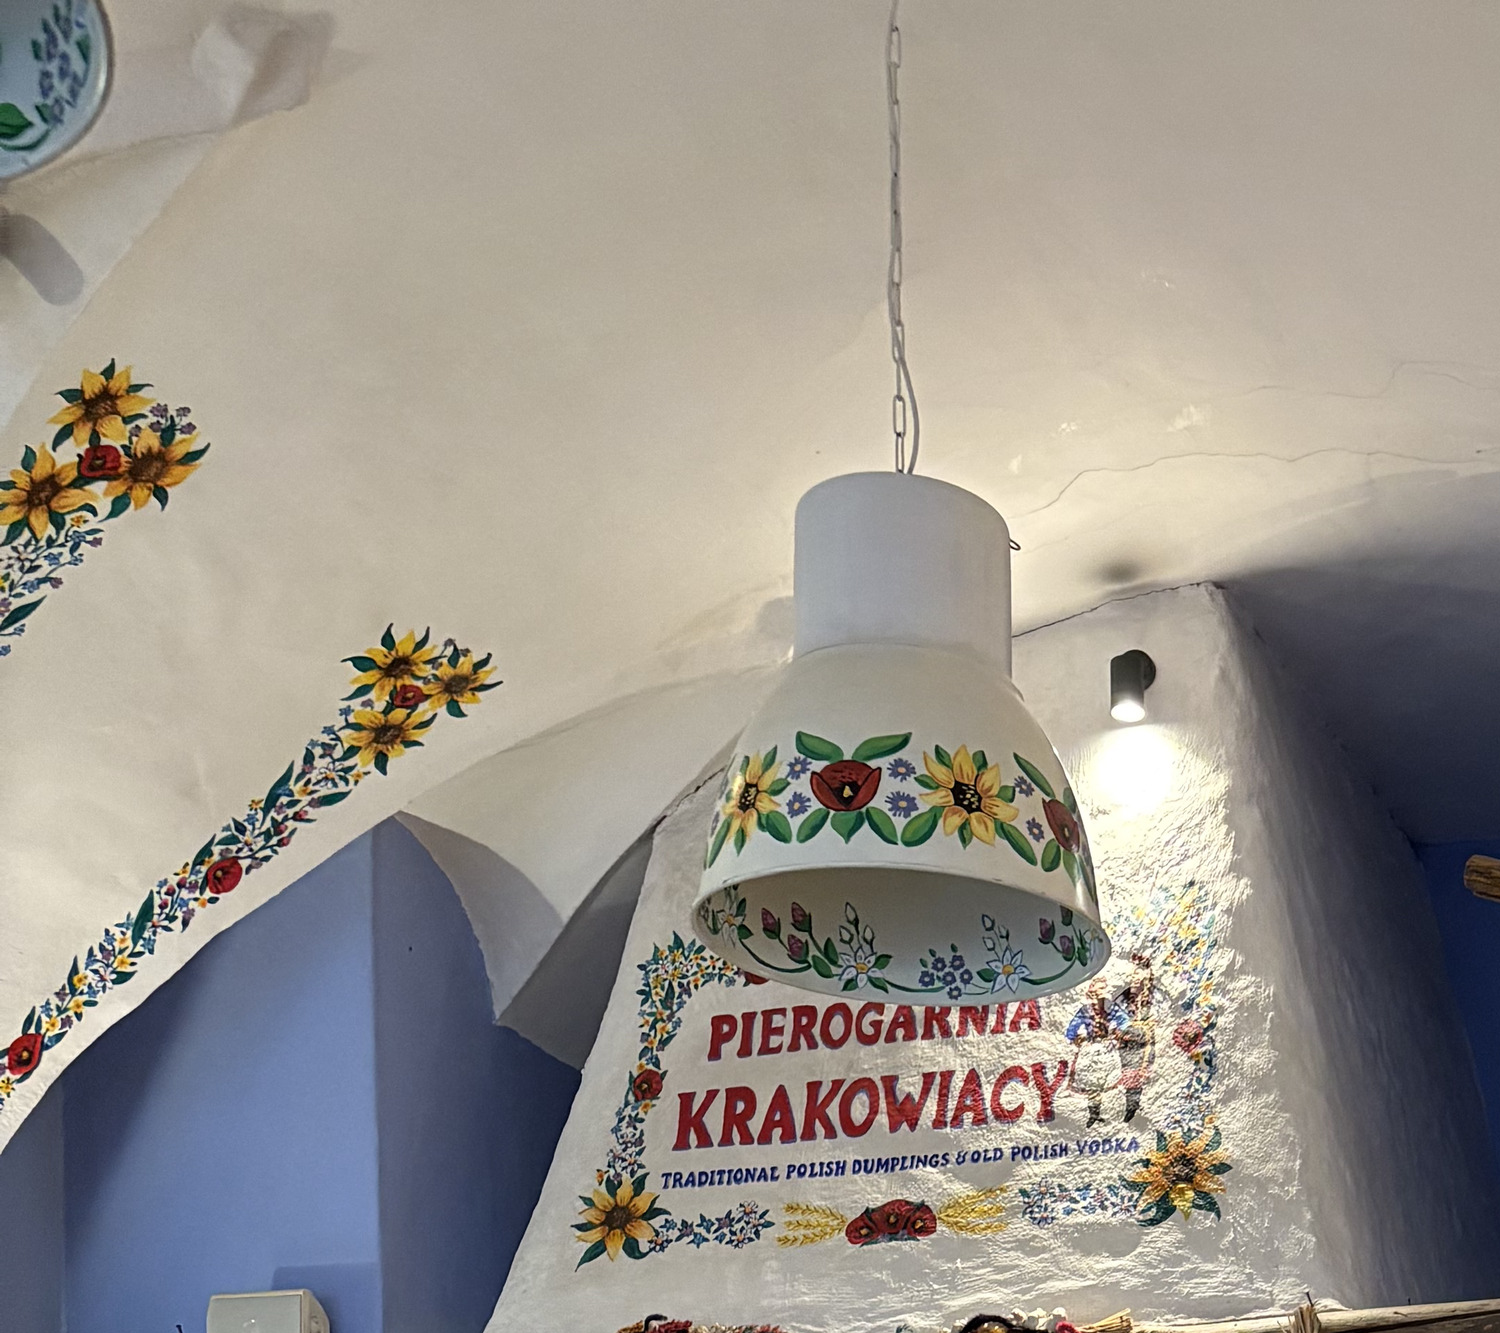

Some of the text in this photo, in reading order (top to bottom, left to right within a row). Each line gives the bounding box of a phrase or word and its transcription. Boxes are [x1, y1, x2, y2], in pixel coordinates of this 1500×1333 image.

[707, 1000, 1043, 1062] PIEROGARNIA
[672, 1060, 1069, 1151] KRAKOWIACY
[661, 1137, 1140, 1190] TRADITIONAL POLISH DUMPLINGS & OLD POLISH VODKA
